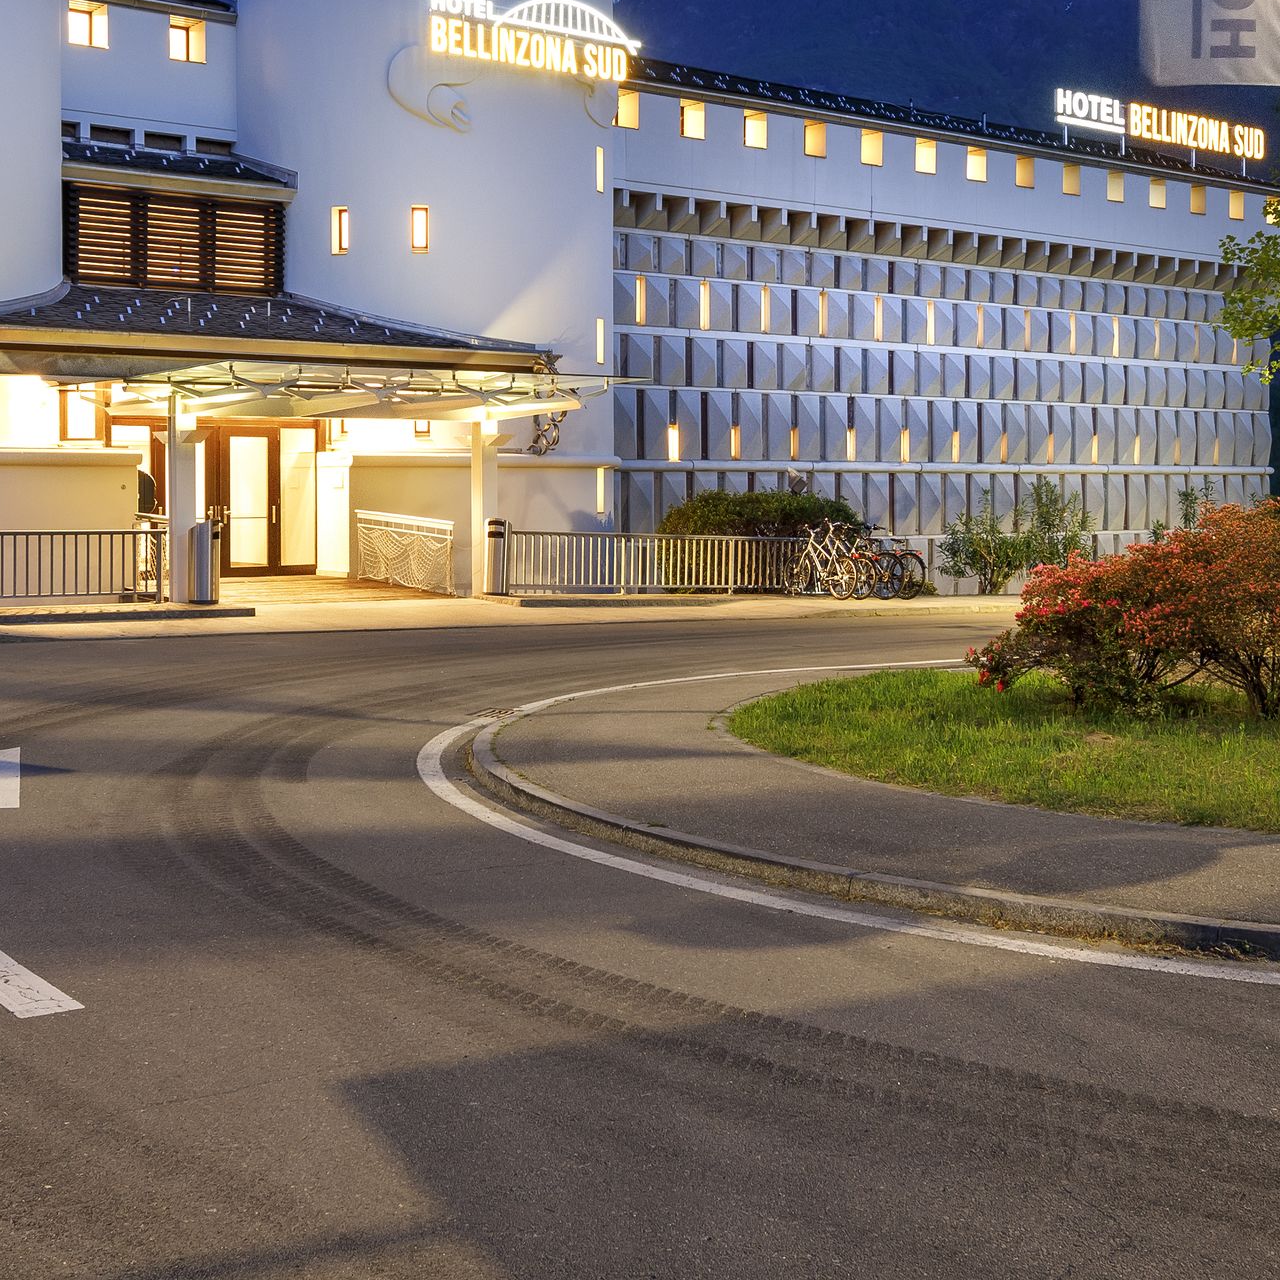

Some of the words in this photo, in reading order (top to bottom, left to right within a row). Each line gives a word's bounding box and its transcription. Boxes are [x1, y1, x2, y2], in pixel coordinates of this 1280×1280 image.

[430, 15, 578, 75] BELLINZONA
[583, 42, 629, 82] SUD
[1056, 87, 1126, 126] HOTEL
[1129, 102, 1231, 154] BELLINZONA
[1233, 124, 1266, 160] SUD
